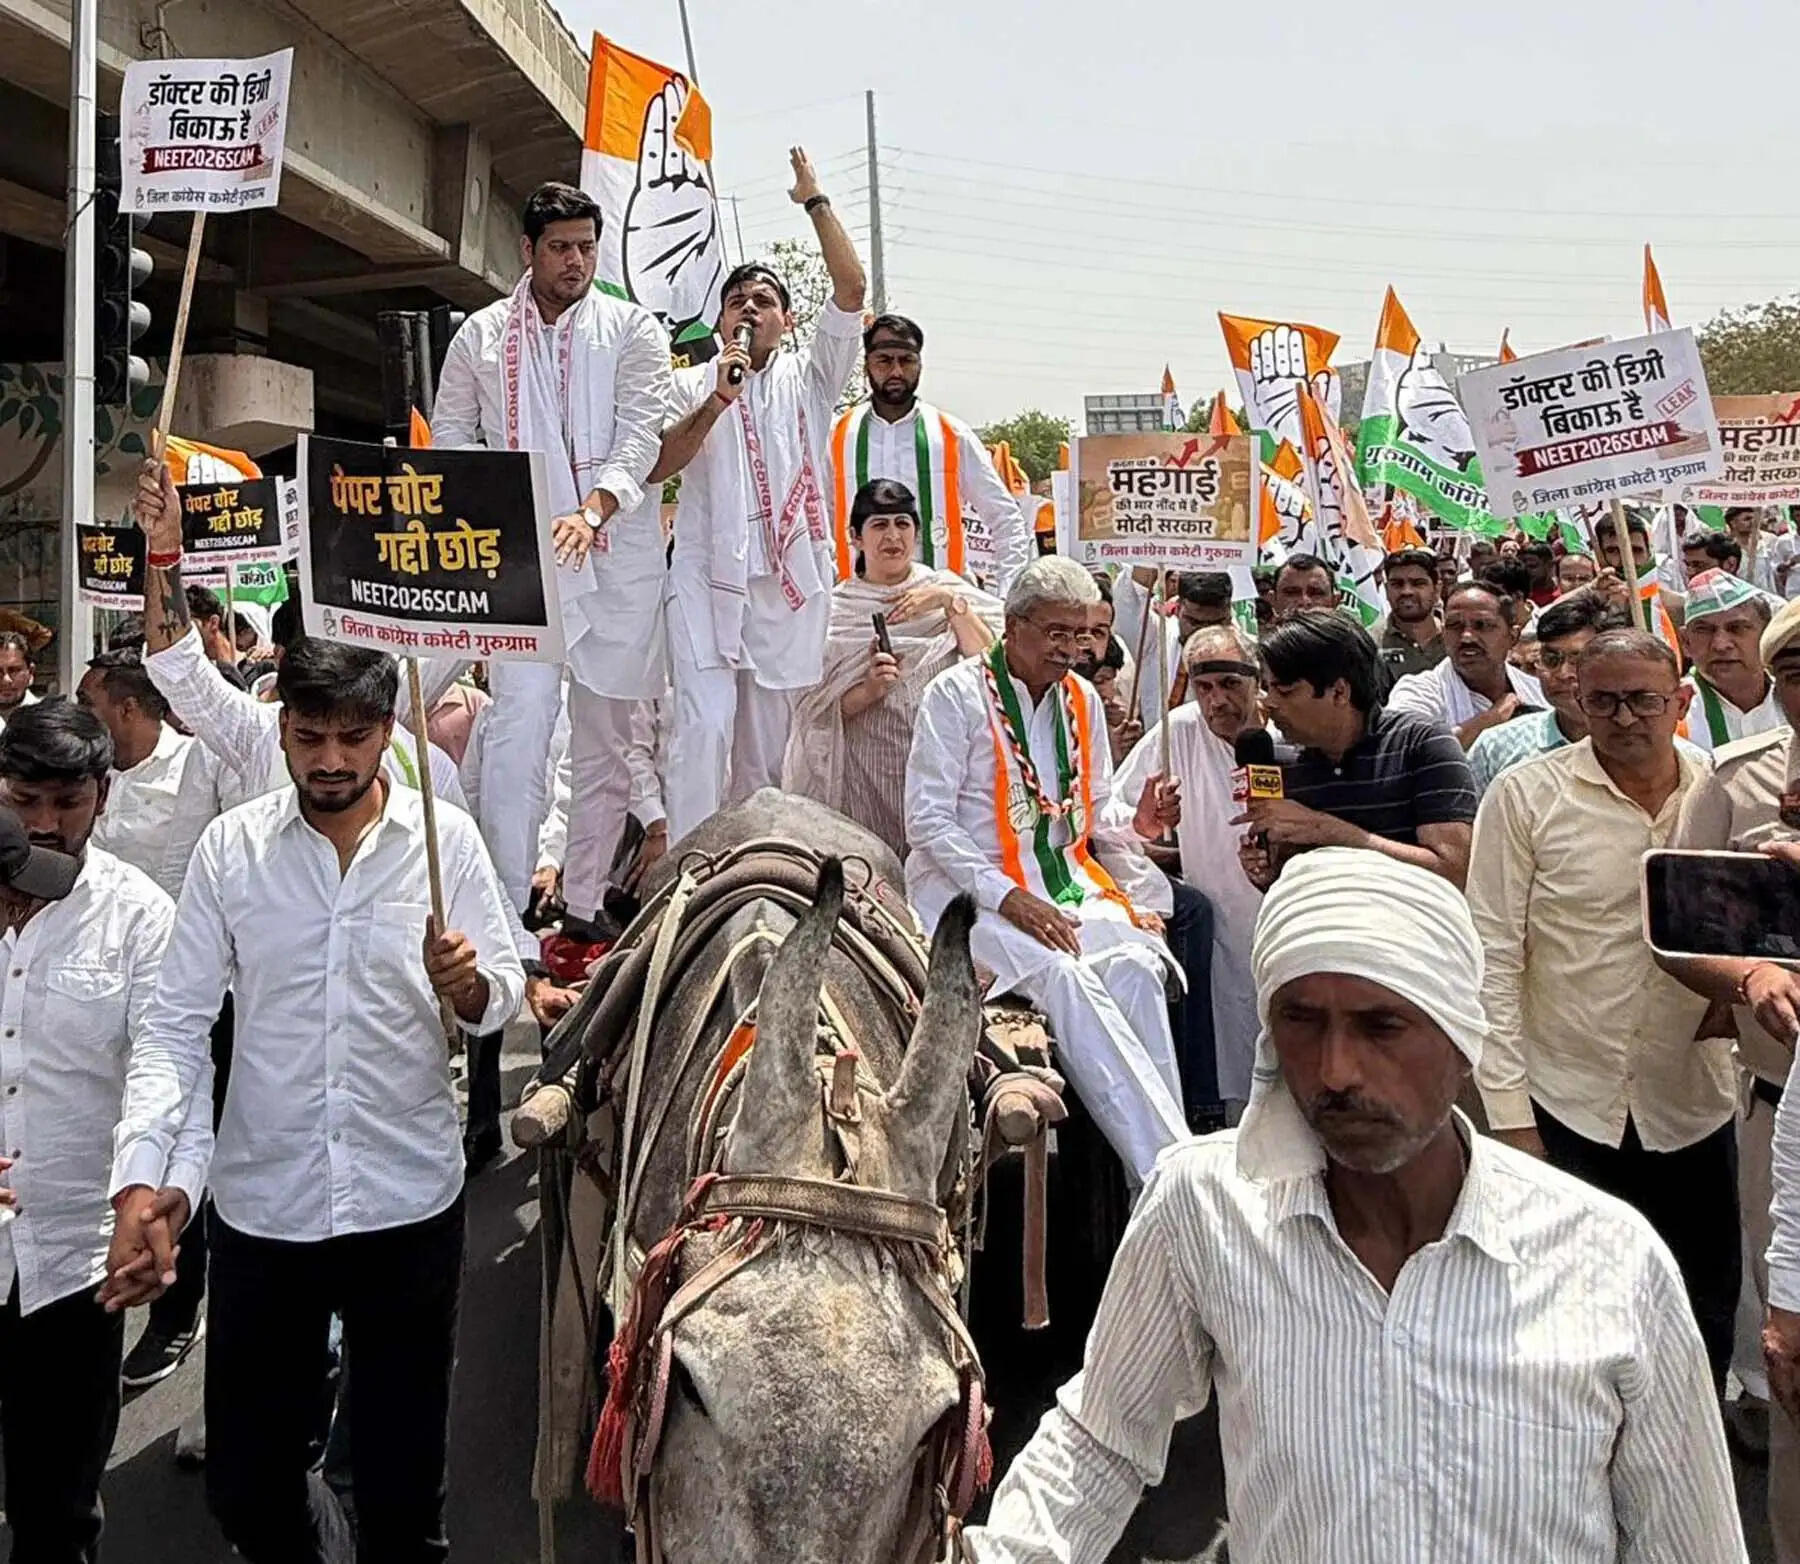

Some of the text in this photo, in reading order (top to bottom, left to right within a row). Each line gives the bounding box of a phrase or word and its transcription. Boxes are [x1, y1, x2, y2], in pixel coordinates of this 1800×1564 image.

[148, 69, 271, 106] डॉक्टर की डिग्री
[169, 109, 251, 140] बिकाऊ है
[154, 148, 255, 169] NEET2026SCAM
[147, 189, 168, 204] जिला
[171, 187, 205, 203] कांग्रेस
[506, 333, 519, 431] CONGRESS
[1499, 348, 1665, 410] डॉक्टर की डिग्री
[1540, 390, 1644, 437] बिकाऊ है
[1664, 383, 1697, 414] LEAK
[1534, 426, 1669, 469] NEET2026SCAM
[1718, 419, 1800, 452] महंगा
[330, 463, 443, 515] पेपर चोर
[1110, 459, 1217, 502] महंगाई
[1532, 460, 1706, 506] जिला कांग्रेस कमेटी गुरुग्राम
[1760, 467, 1800, 482] सरक
[186, 487, 239, 513] पेपर चोर
[1116, 498, 1131, 511] की
[1135, 499, 1153, 510] मार
[1190, 498, 1199, 512] है
[233, 506, 263, 530] छोड़
[1116, 514, 1213, 534] मोदी सरकार
[374, 519, 501, 579] गद्दी छोड़
[1101, 542, 1243, 561] जिला कांग्रेस कमेटी गुरुग्राम
[351, 579, 490, 614] NEET2026SCAM
[340, 615, 537, 656] जिला कांग्रेस कमेटी गुरुग्राम
